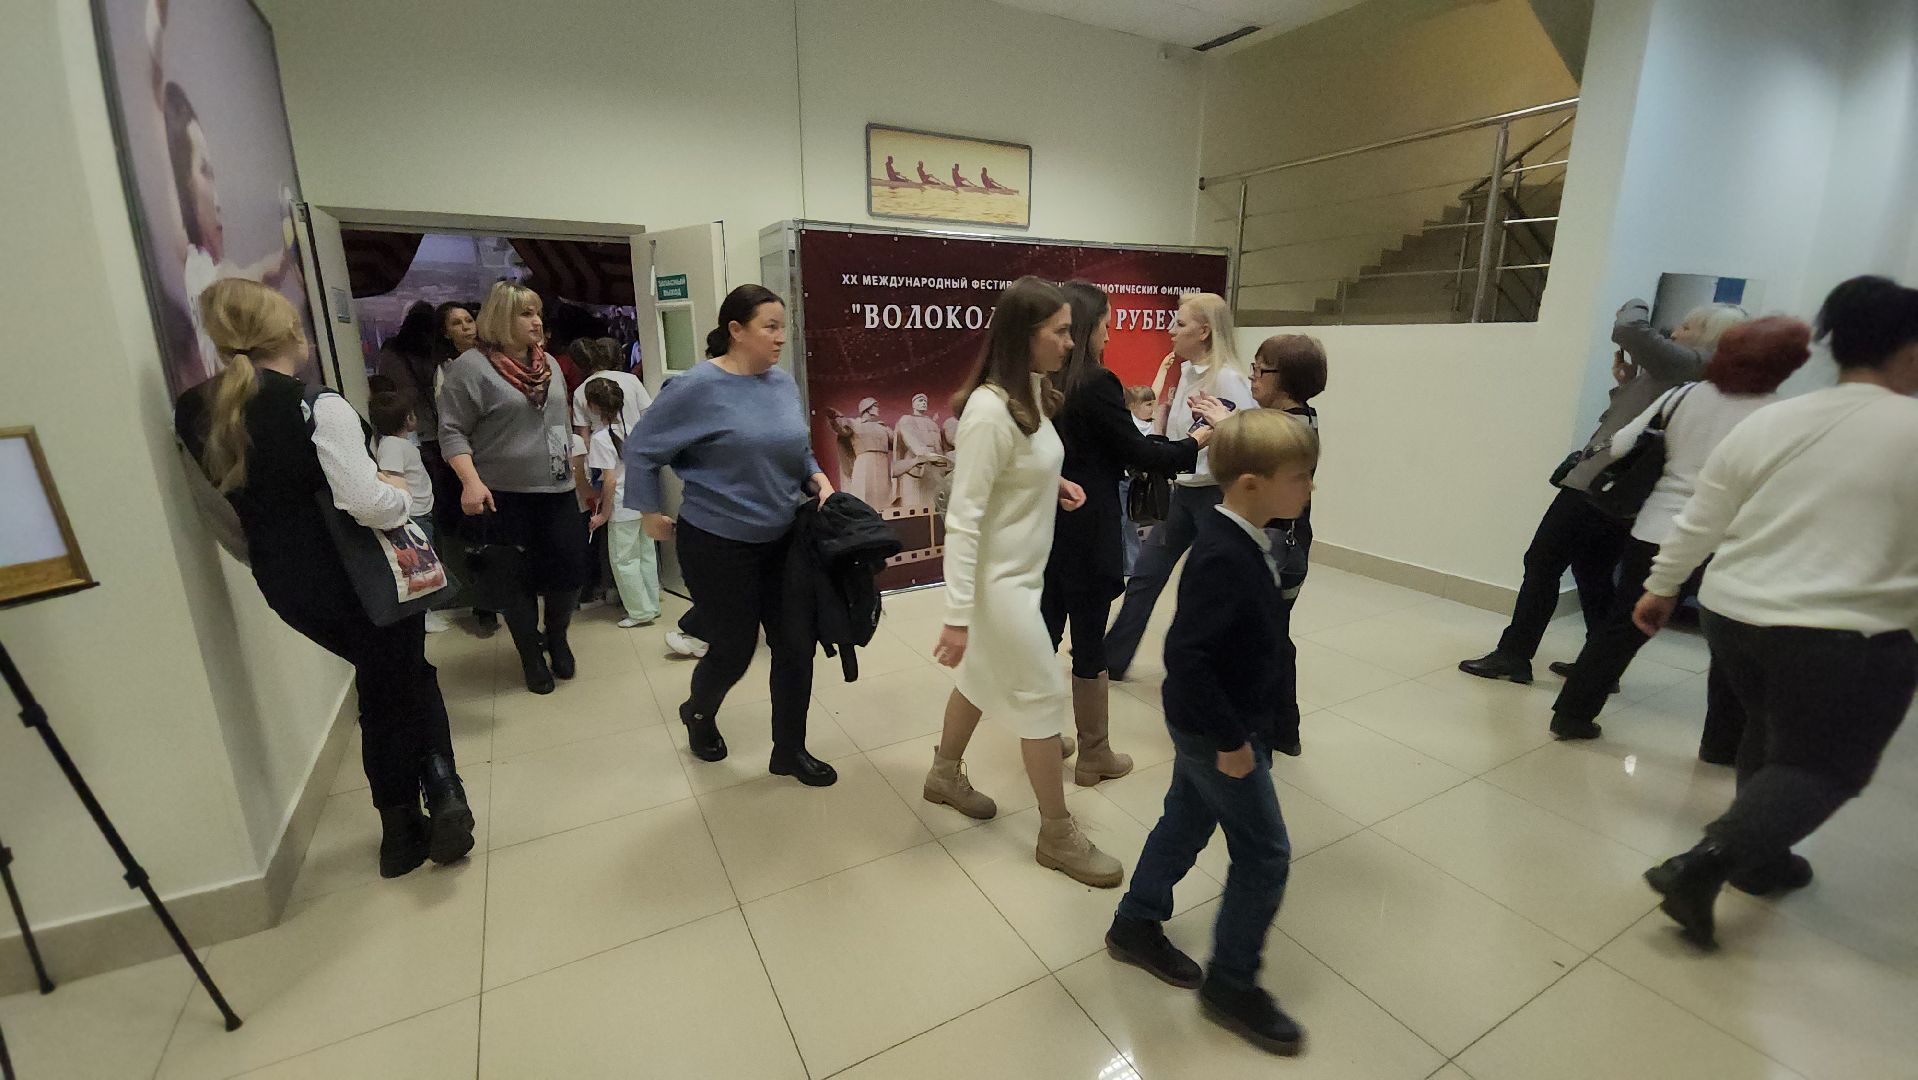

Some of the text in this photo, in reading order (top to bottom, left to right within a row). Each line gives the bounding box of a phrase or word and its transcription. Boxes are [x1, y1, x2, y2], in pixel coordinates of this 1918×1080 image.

[658, 279, 686, 288] ЗАПАСНЫЙ
[862, 275, 968, 289] МЕЖДУНАРОДНЫЙ
[971, 279, 1014, 291] ФЕСТИВ
[1092, 283, 1159, 295] РИОТИЧЕСКИХ
[663, 288, 682, 296] ВЫХОД
[851, 303, 998, 330] "ВОЛОКО
